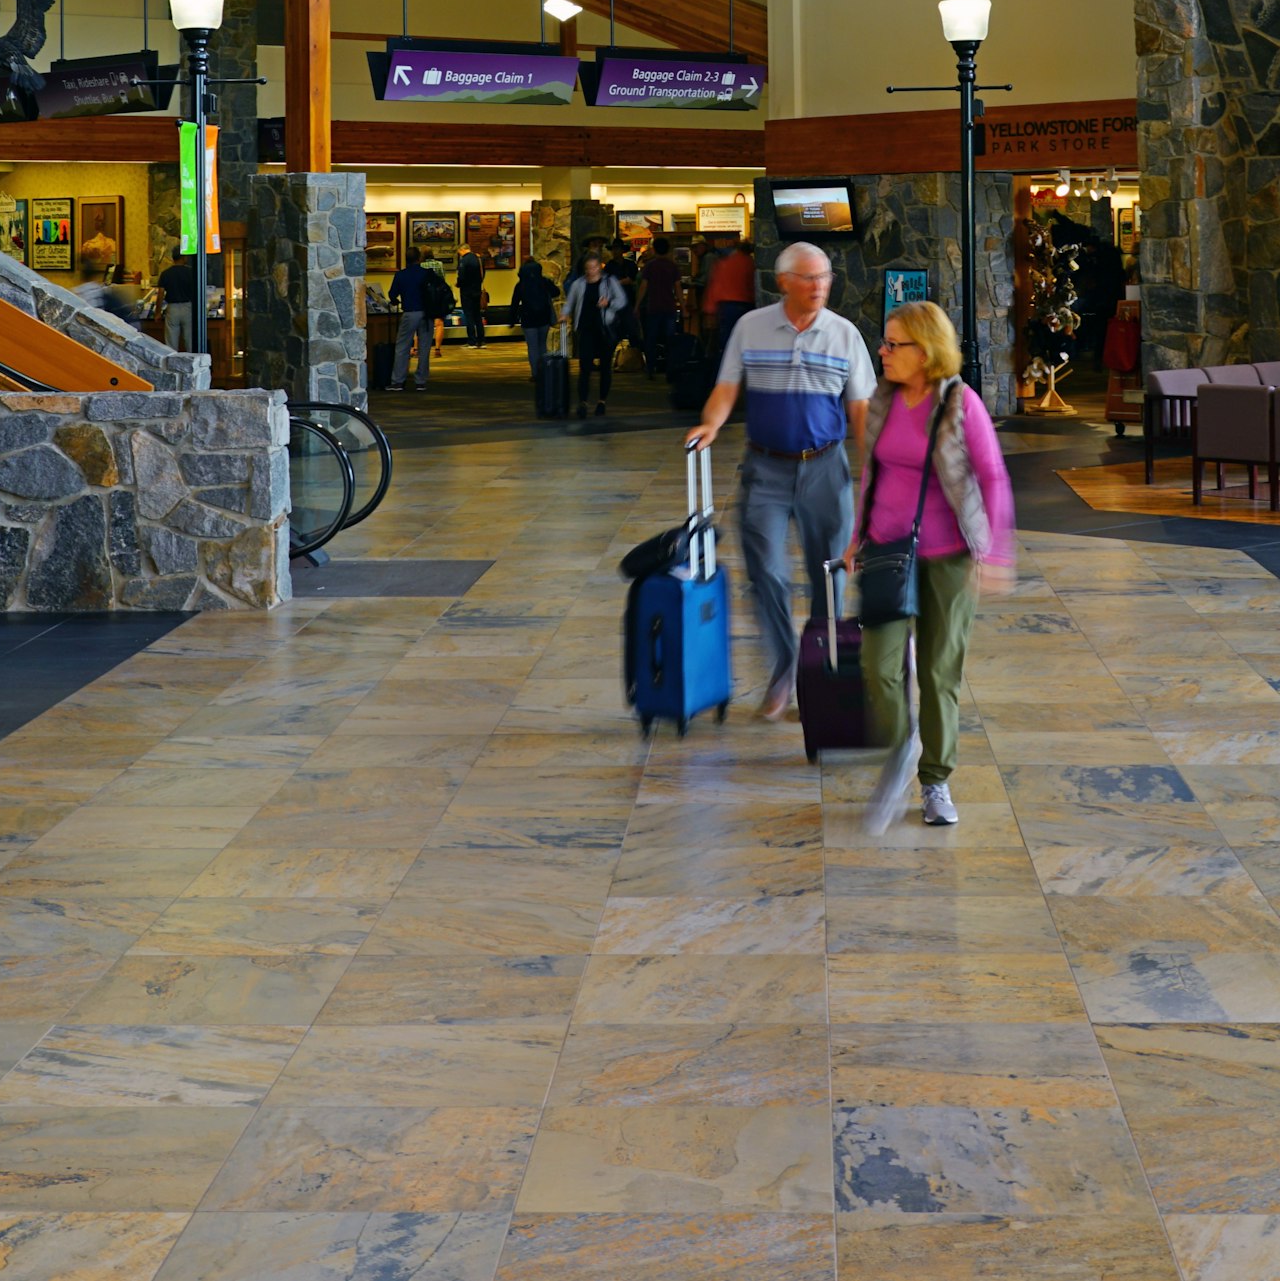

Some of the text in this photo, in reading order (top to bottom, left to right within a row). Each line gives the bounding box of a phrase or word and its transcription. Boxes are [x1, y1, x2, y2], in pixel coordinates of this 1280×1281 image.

[62, 75, 110, 90] Taxi, Rideshare
[445, 70, 533, 86] Baggage Claim 1
[632, 68, 720, 83] Baggage Claim 2-3
[73, 93, 116, 106] Shuttles, Bus
[608, 84, 716, 100] Ground Transportation
[989, 118, 1098, 138] YELLOWSTONE
[992, 136, 1111, 154] PARK STORE
